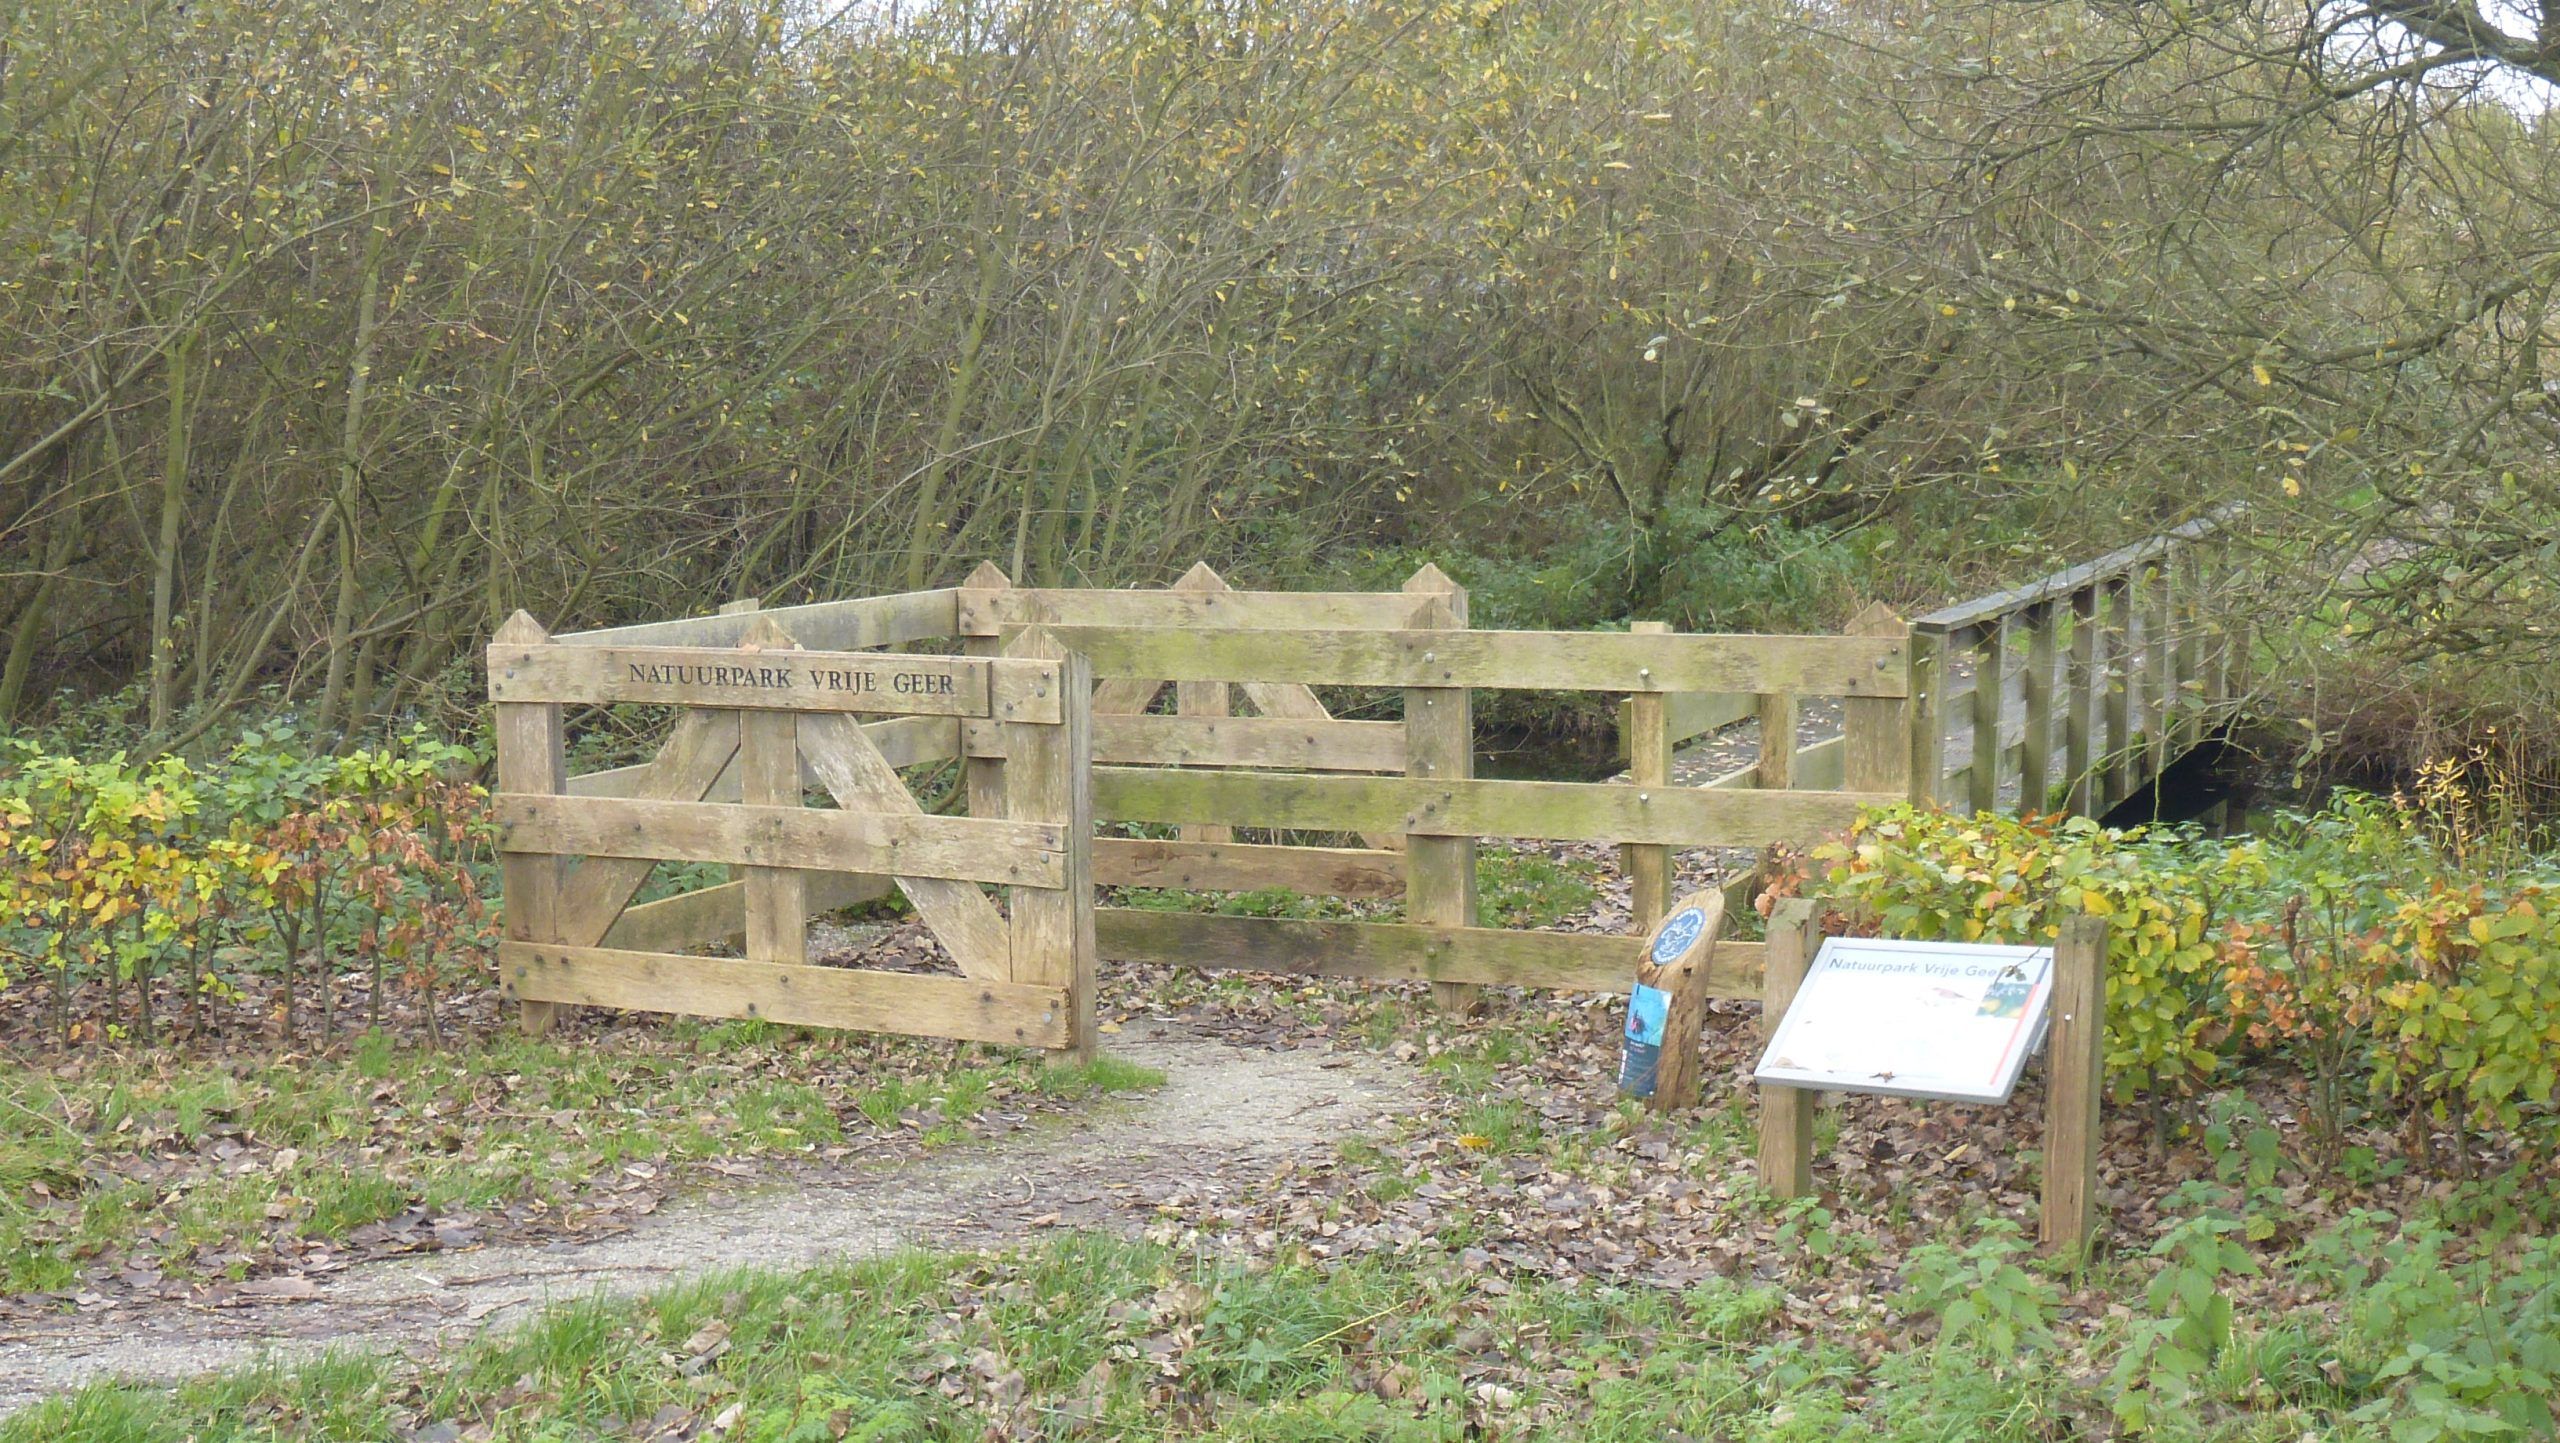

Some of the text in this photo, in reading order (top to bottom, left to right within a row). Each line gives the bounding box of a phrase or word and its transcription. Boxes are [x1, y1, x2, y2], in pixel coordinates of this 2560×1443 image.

[628, 663, 954, 696] NATUURPARK VRIJE GEER
[1829, 958, 1918, 975] Natuurpark
[1925, 962, 1959, 978] Vrije
